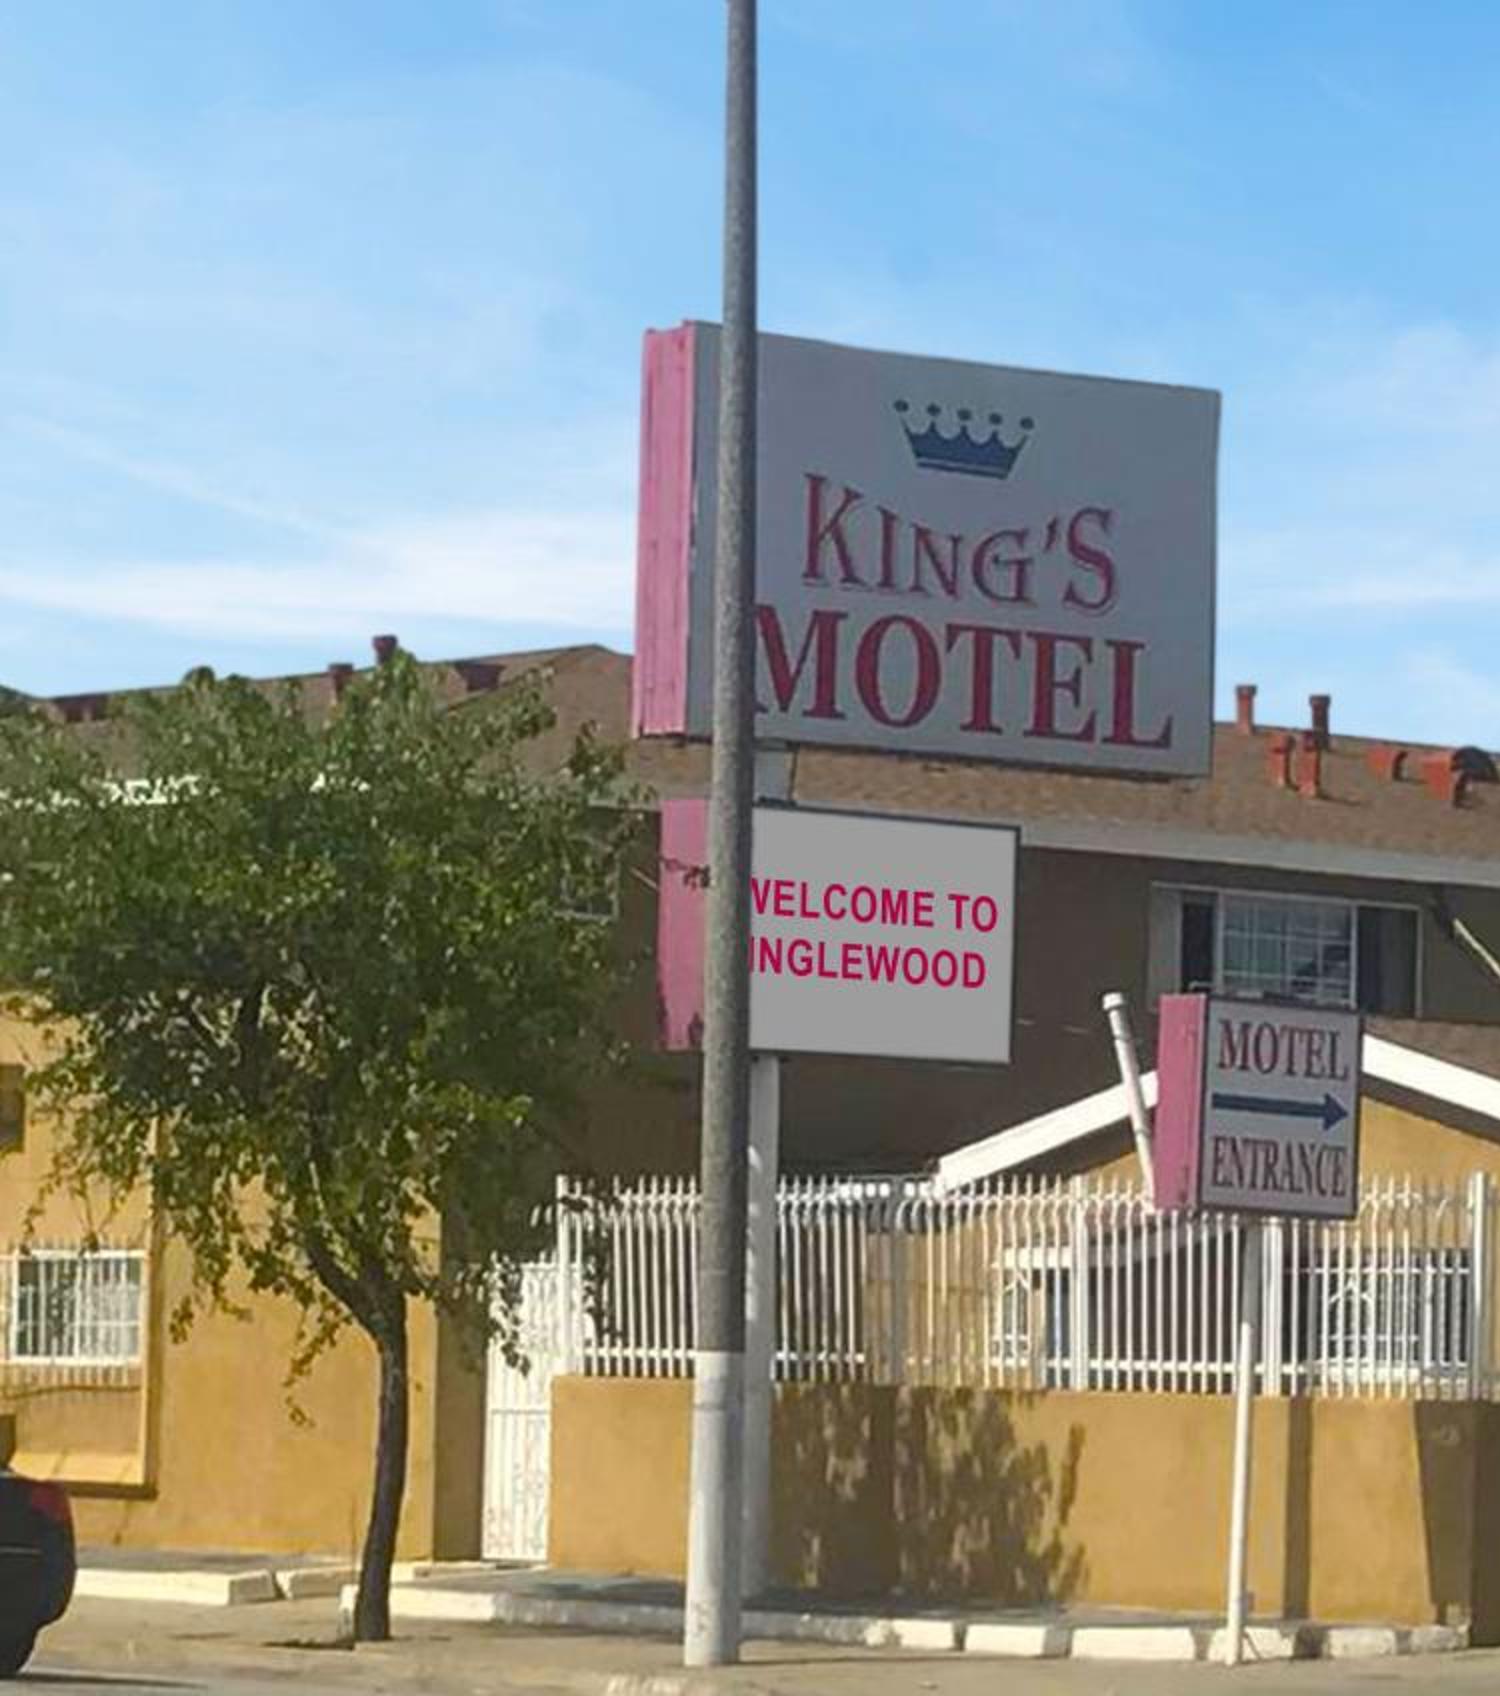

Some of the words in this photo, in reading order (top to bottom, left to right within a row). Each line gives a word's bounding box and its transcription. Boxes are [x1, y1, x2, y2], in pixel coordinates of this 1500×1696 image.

[802, 473, 1117, 616] KING'S
[755, 604, 1172, 750] MOTEL
[948, 893, 998, 933] TO
[750, 937, 987, 989] INGLEWOOD
[1217, 1019, 1348, 1081] MOTEL
[1212, 1136, 1348, 1197] ENTRANCE
